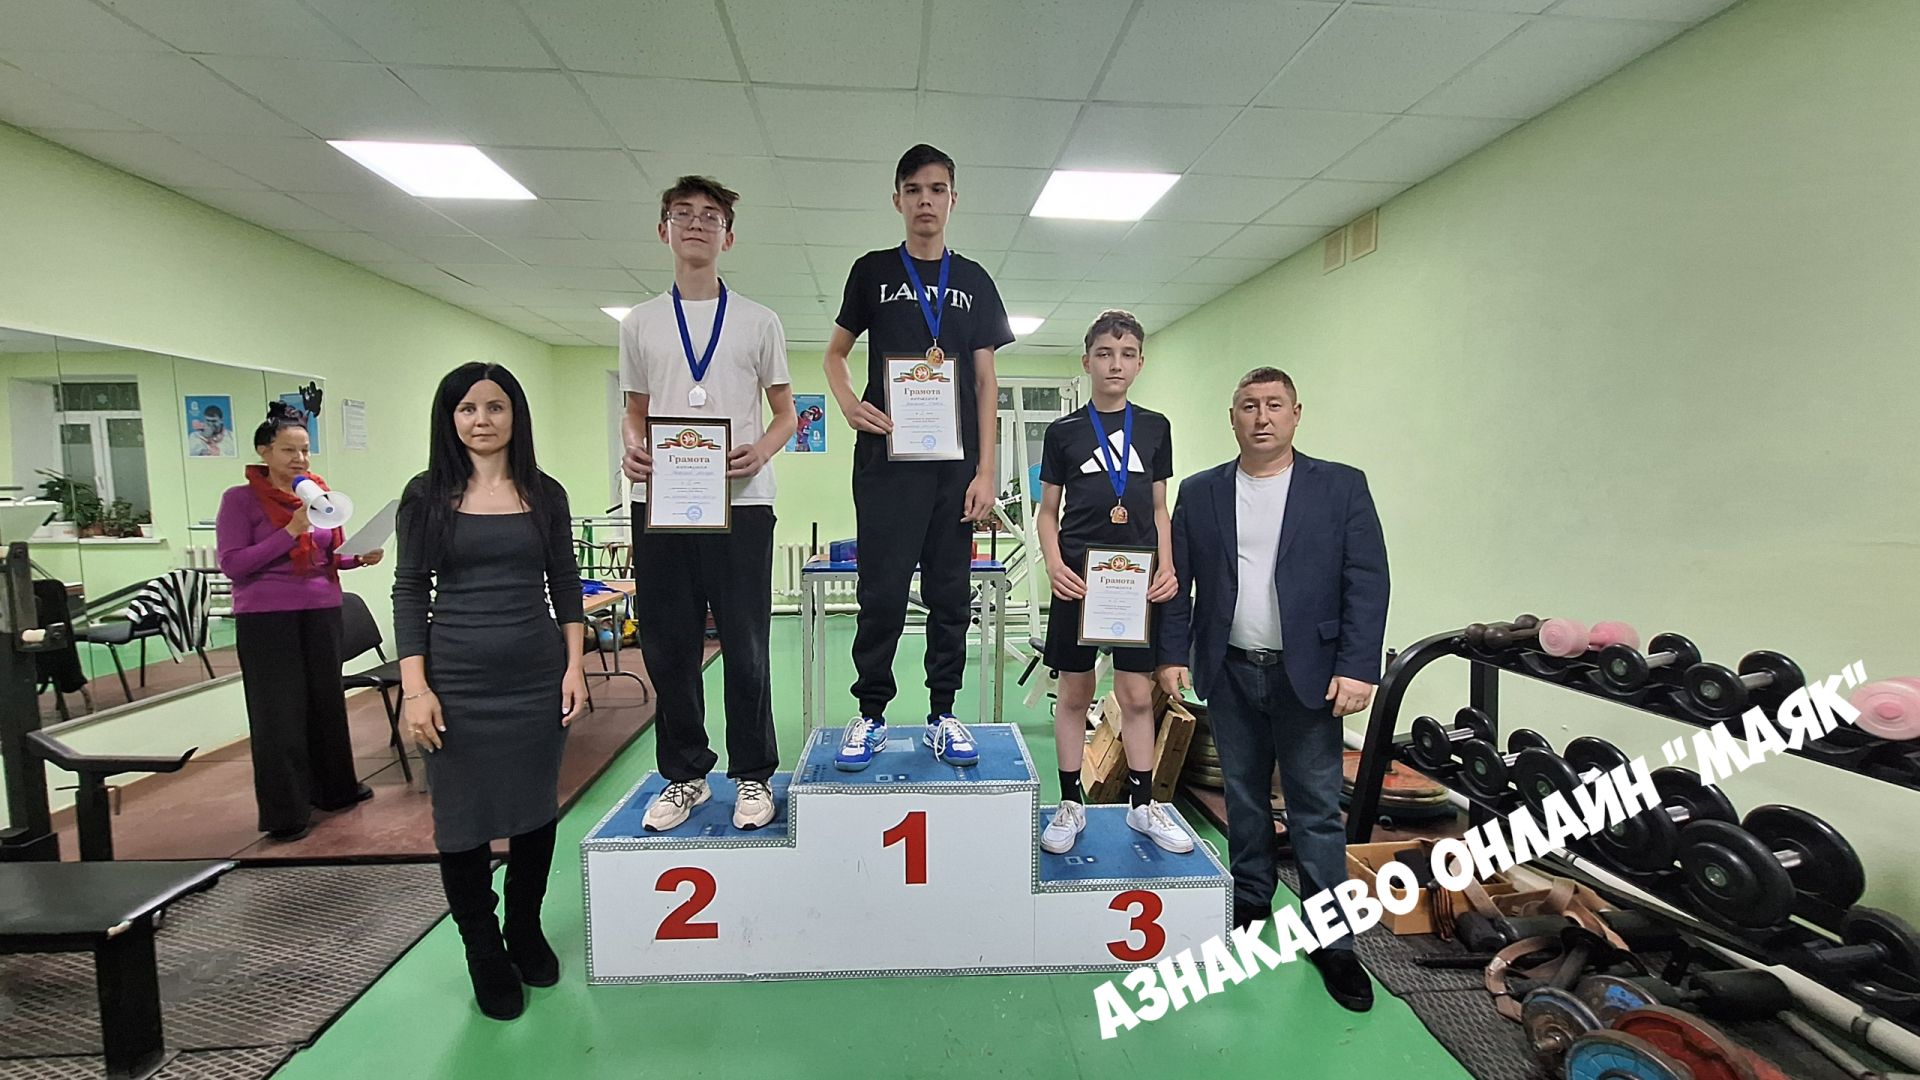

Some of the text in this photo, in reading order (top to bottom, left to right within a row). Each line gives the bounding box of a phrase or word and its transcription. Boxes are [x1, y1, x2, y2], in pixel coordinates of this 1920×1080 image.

[904, 387, 941, 396] Грамота
[668, 454, 711, 464] Грамота
[1100, 576, 1135, 585] Грамота
[882, 811, 928, 885] 1
[654, 867, 719, 941] 2
[1106, 889, 1167, 962] 3
